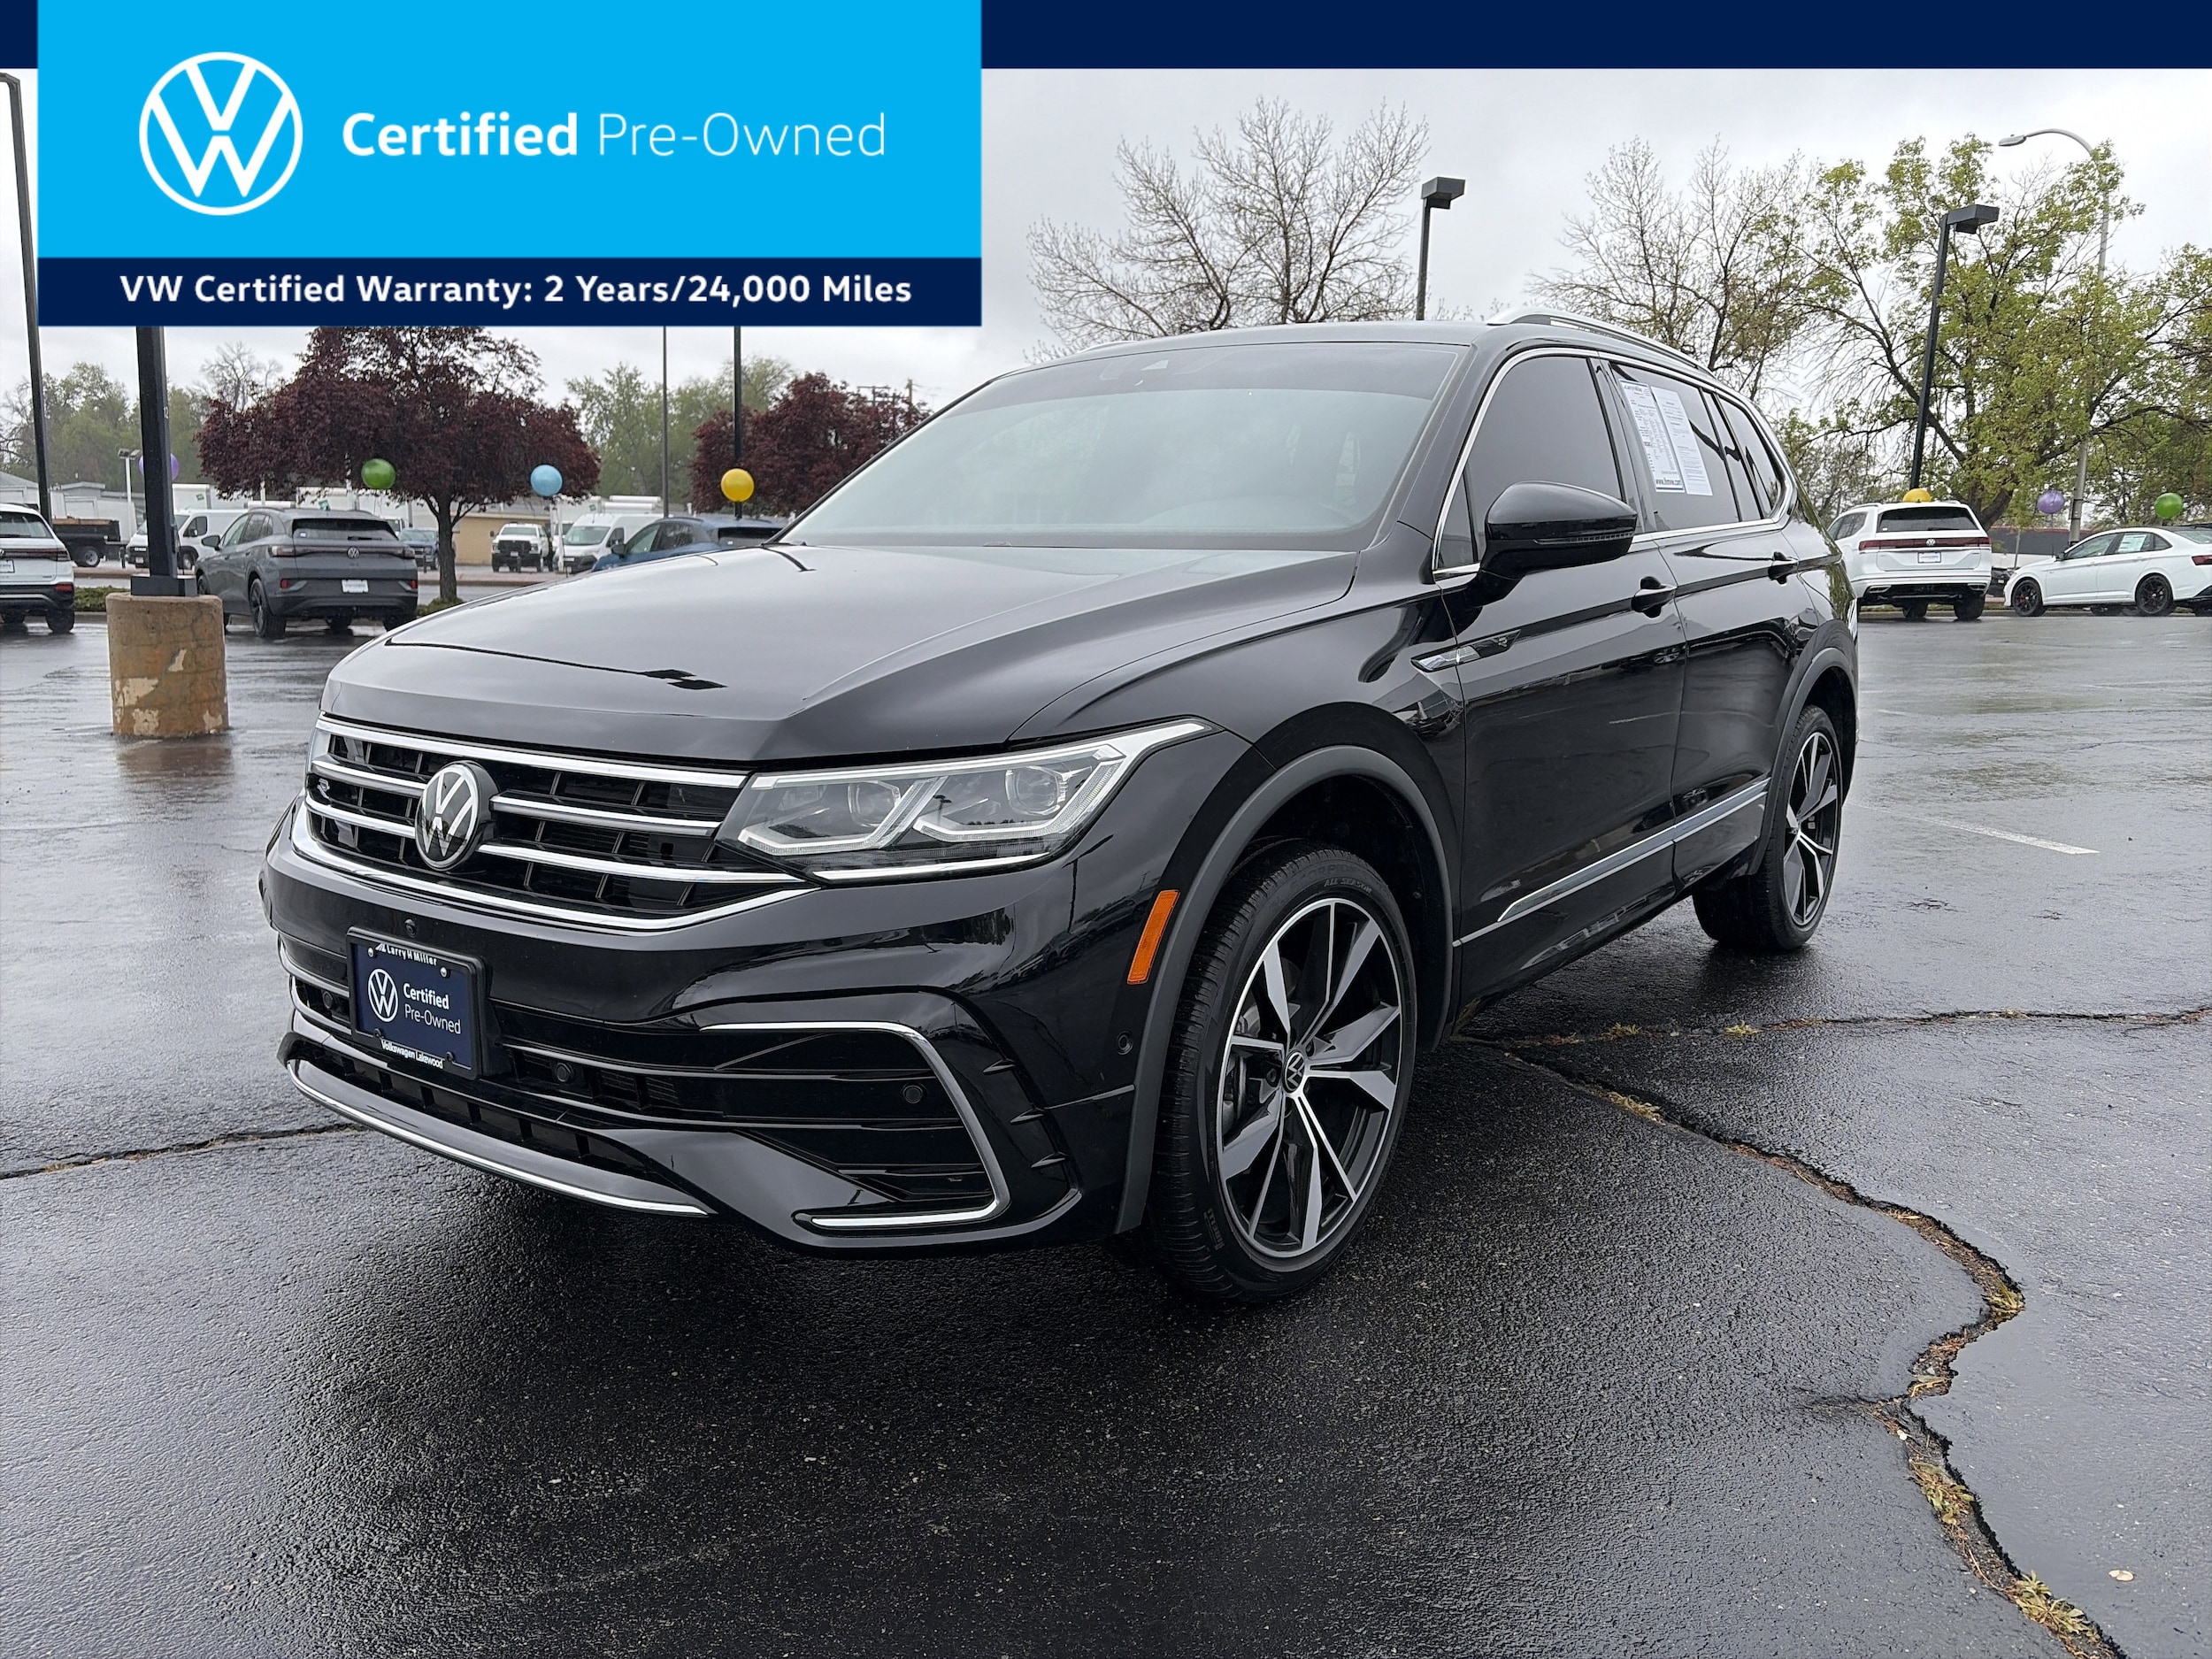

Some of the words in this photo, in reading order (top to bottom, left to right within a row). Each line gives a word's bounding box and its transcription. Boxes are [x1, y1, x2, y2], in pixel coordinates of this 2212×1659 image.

[387, 944, 406, 960] Larry
[407, 950, 413, 959] H
[413, 952, 437, 965] Miller
[403, 983, 449, 1010] Certified
[404, 1003, 462, 1034] Pre-Owned
[380, 1039, 416, 1059] Volkswagen
[416, 1051, 443, 1069] Lakewood
